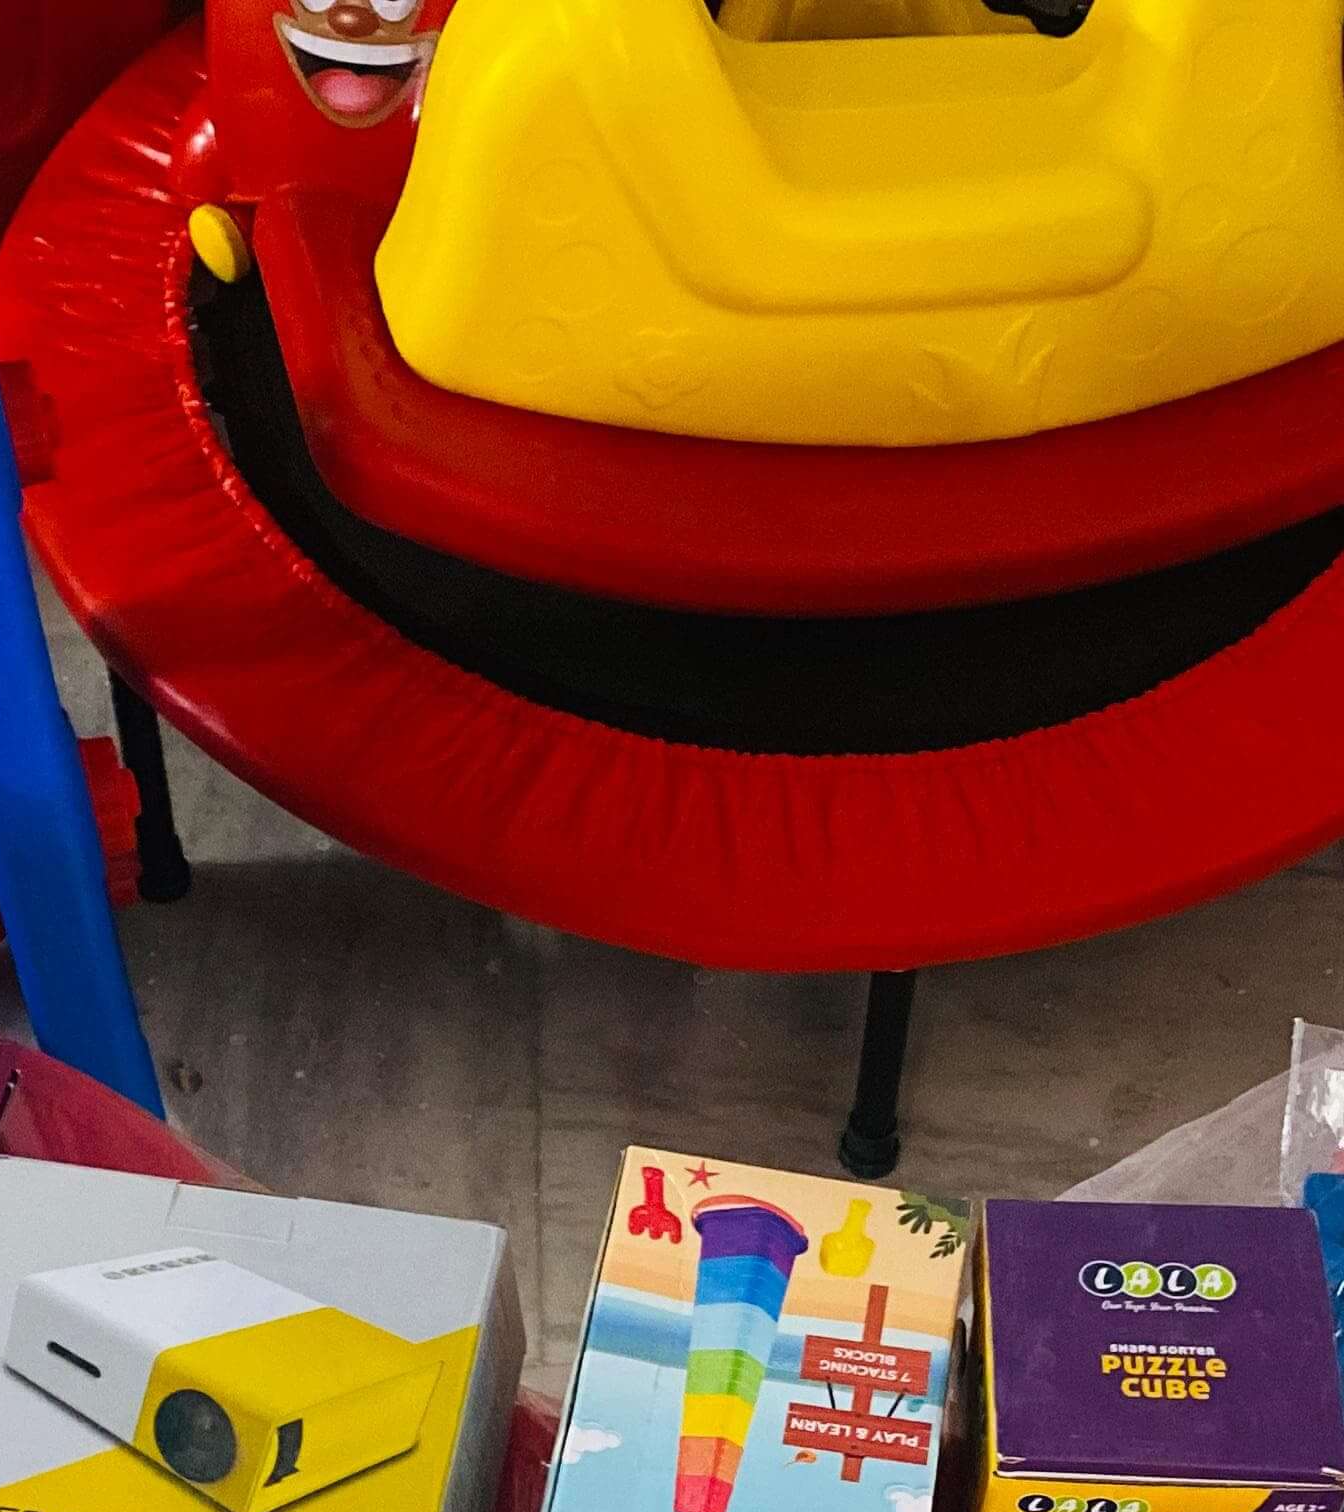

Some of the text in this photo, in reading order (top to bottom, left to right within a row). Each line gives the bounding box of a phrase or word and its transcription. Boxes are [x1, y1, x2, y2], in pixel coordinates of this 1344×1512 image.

[1086, 1263, 1231, 1297] LALA
[819, 1359, 899, 1382] STACKING
[831, 1346, 898, 1367] BLOCKS
[790, 1416, 920, 1449] PLAY & LEARN
